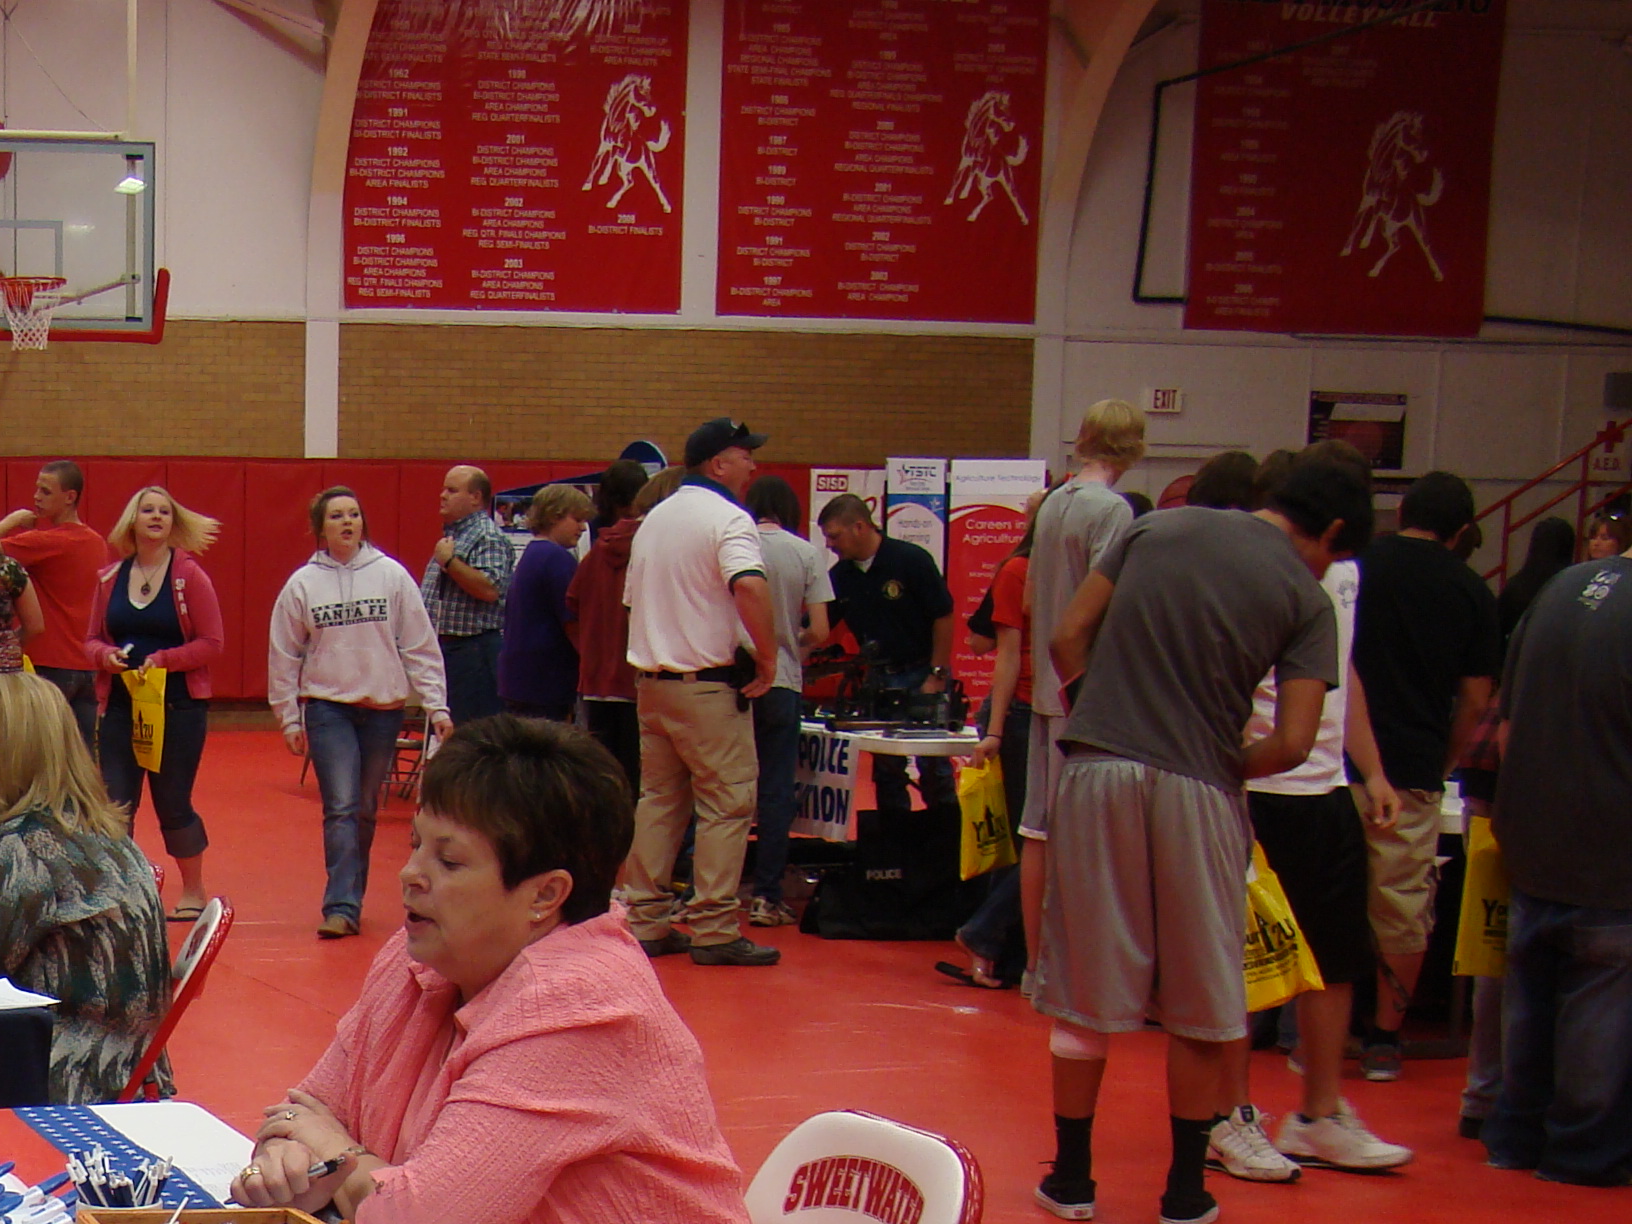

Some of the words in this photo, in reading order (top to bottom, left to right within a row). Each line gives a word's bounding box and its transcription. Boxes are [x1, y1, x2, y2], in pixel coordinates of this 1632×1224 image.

[1280, 3, 1438, 28] VOLLEYALL
[355, 157, 390, 167] DISTRICT
[393, 158, 440, 168] CHAMPIONS
[349, 168, 396, 177] BI-DISTRICT
[398, 169, 445, 178] CHAMPIONS
[365, 179, 387, 188] AREA
[389, 179, 429, 188] FINALISTS
[354, 207, 389, 216] DISTRICT
[392, 208, 440, 218] CHAMPIONS
[354, 217, 399, 227] BI-DISTRICT
[402, 218, 441, 228] FINALISTS
[357, 246, 389, 255] DISTRICT
[391, 247, 434, 256] CHAMPIONS
[353, 256, 394, 266] BI-DISTRICT
[396, 257, 438, 267] CHAMPIONS
[363, 267, 383, 276] AREA
[384, 268, 426, 278] CHAMPIONS
[1153, 389, 1177, 409] EXIT
[817, 476, 848, 491] SISD
[955, 474, 996, 484] Agriculture
[997, 474, 1041, 484] Technology
[965, 519, 1012, 531] Careers
[962, 532, 1024, 546] Agricultur
[313, 606, 363, 623] SANTA
[369, 604, 387, 616] FE
[866, 868, 902, 881] POLICE
